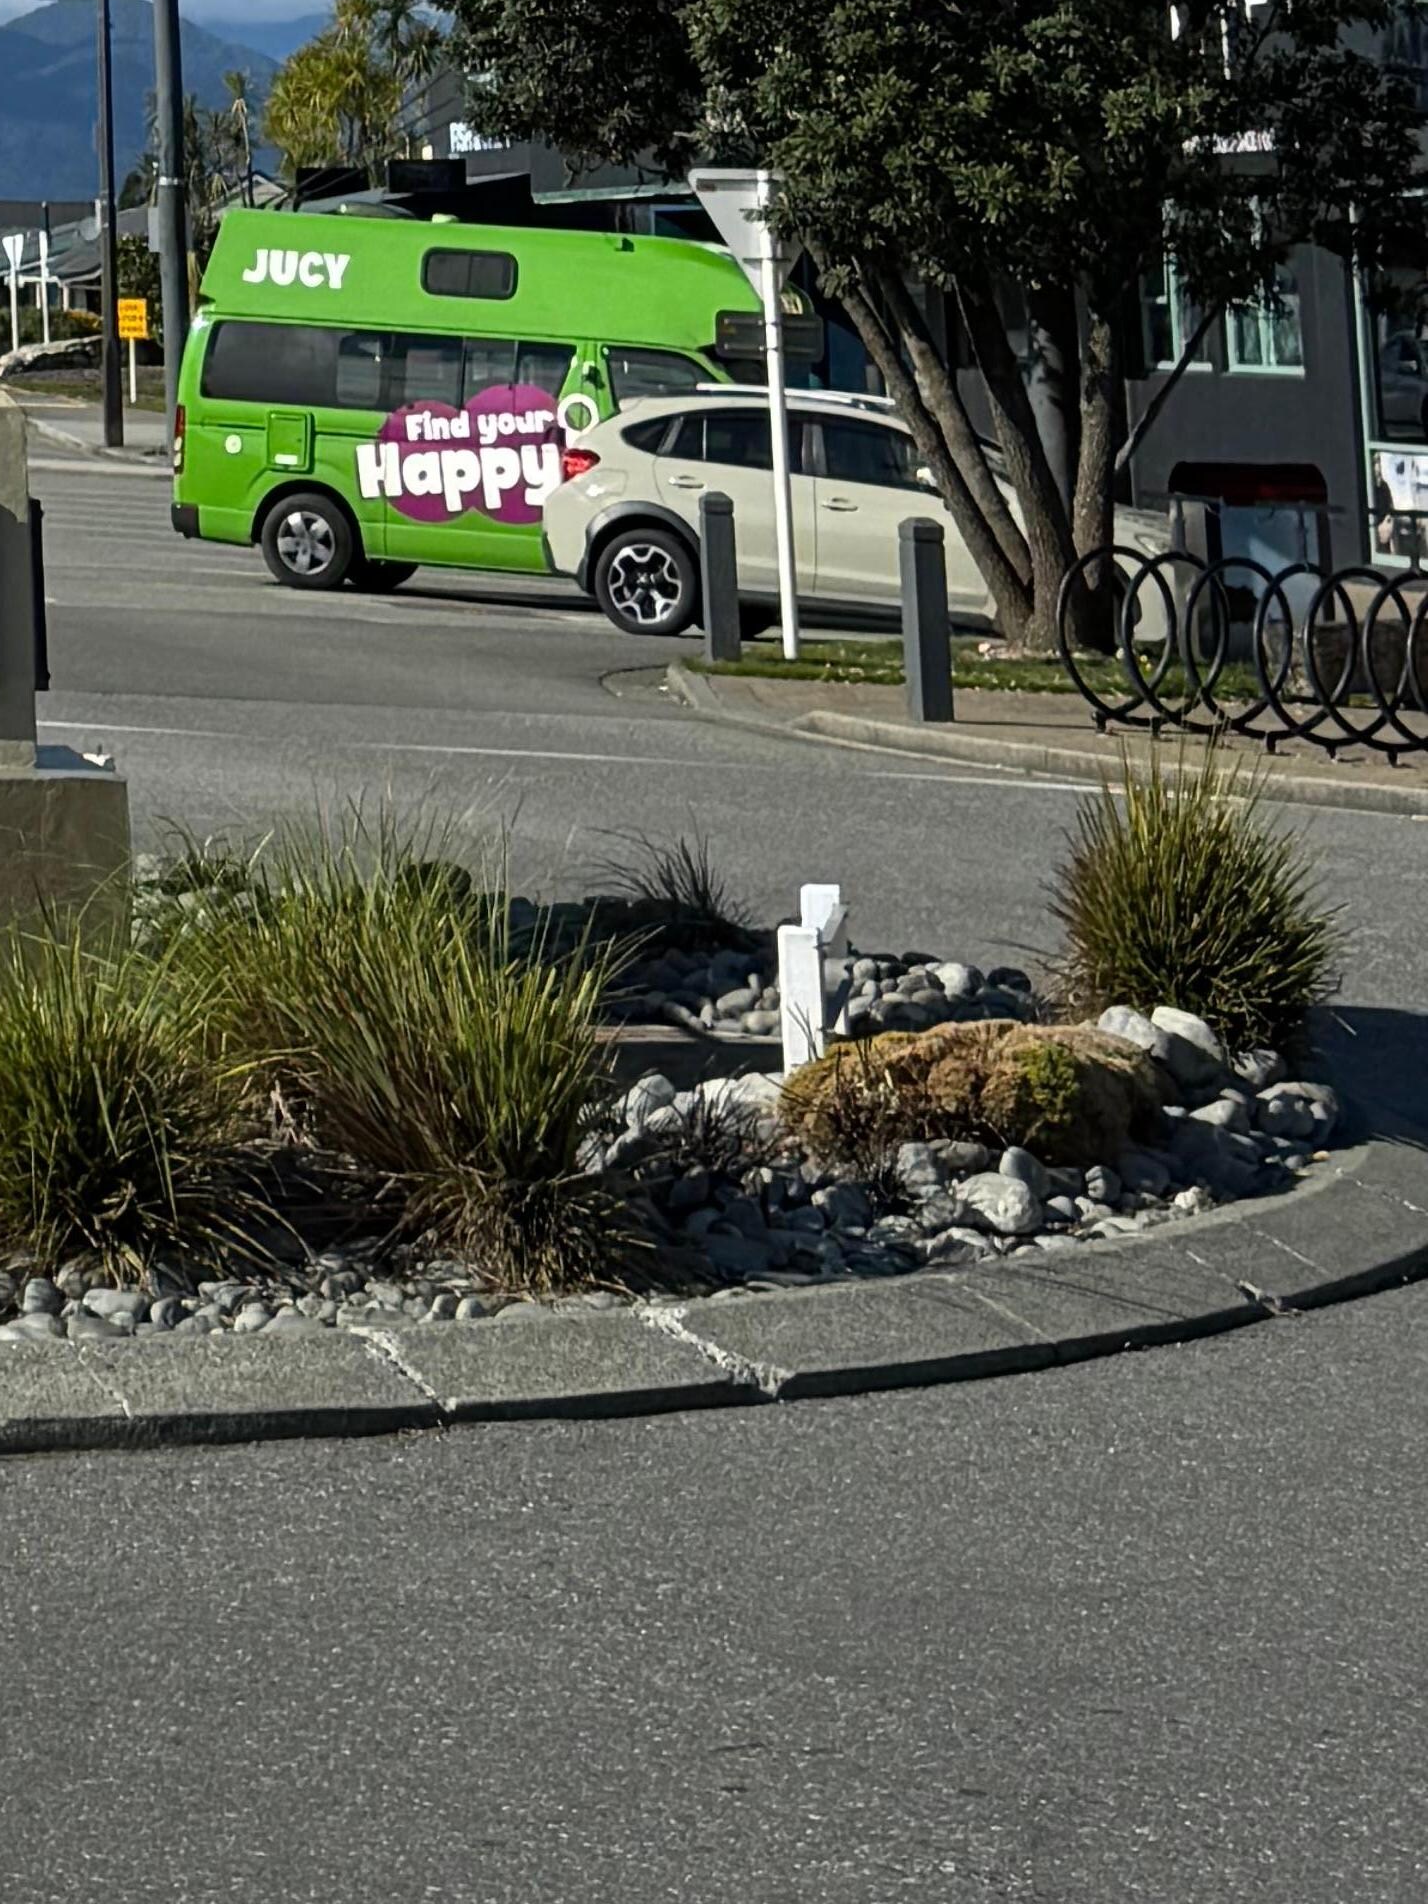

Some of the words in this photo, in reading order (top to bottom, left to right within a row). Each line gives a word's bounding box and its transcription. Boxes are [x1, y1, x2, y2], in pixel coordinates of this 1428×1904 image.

[242, 248, 351, 289] JUCY
[405, 410, 471, 441] Find
[477, 409, 555, 445] your
[356, 441, 562, 512] Happy
